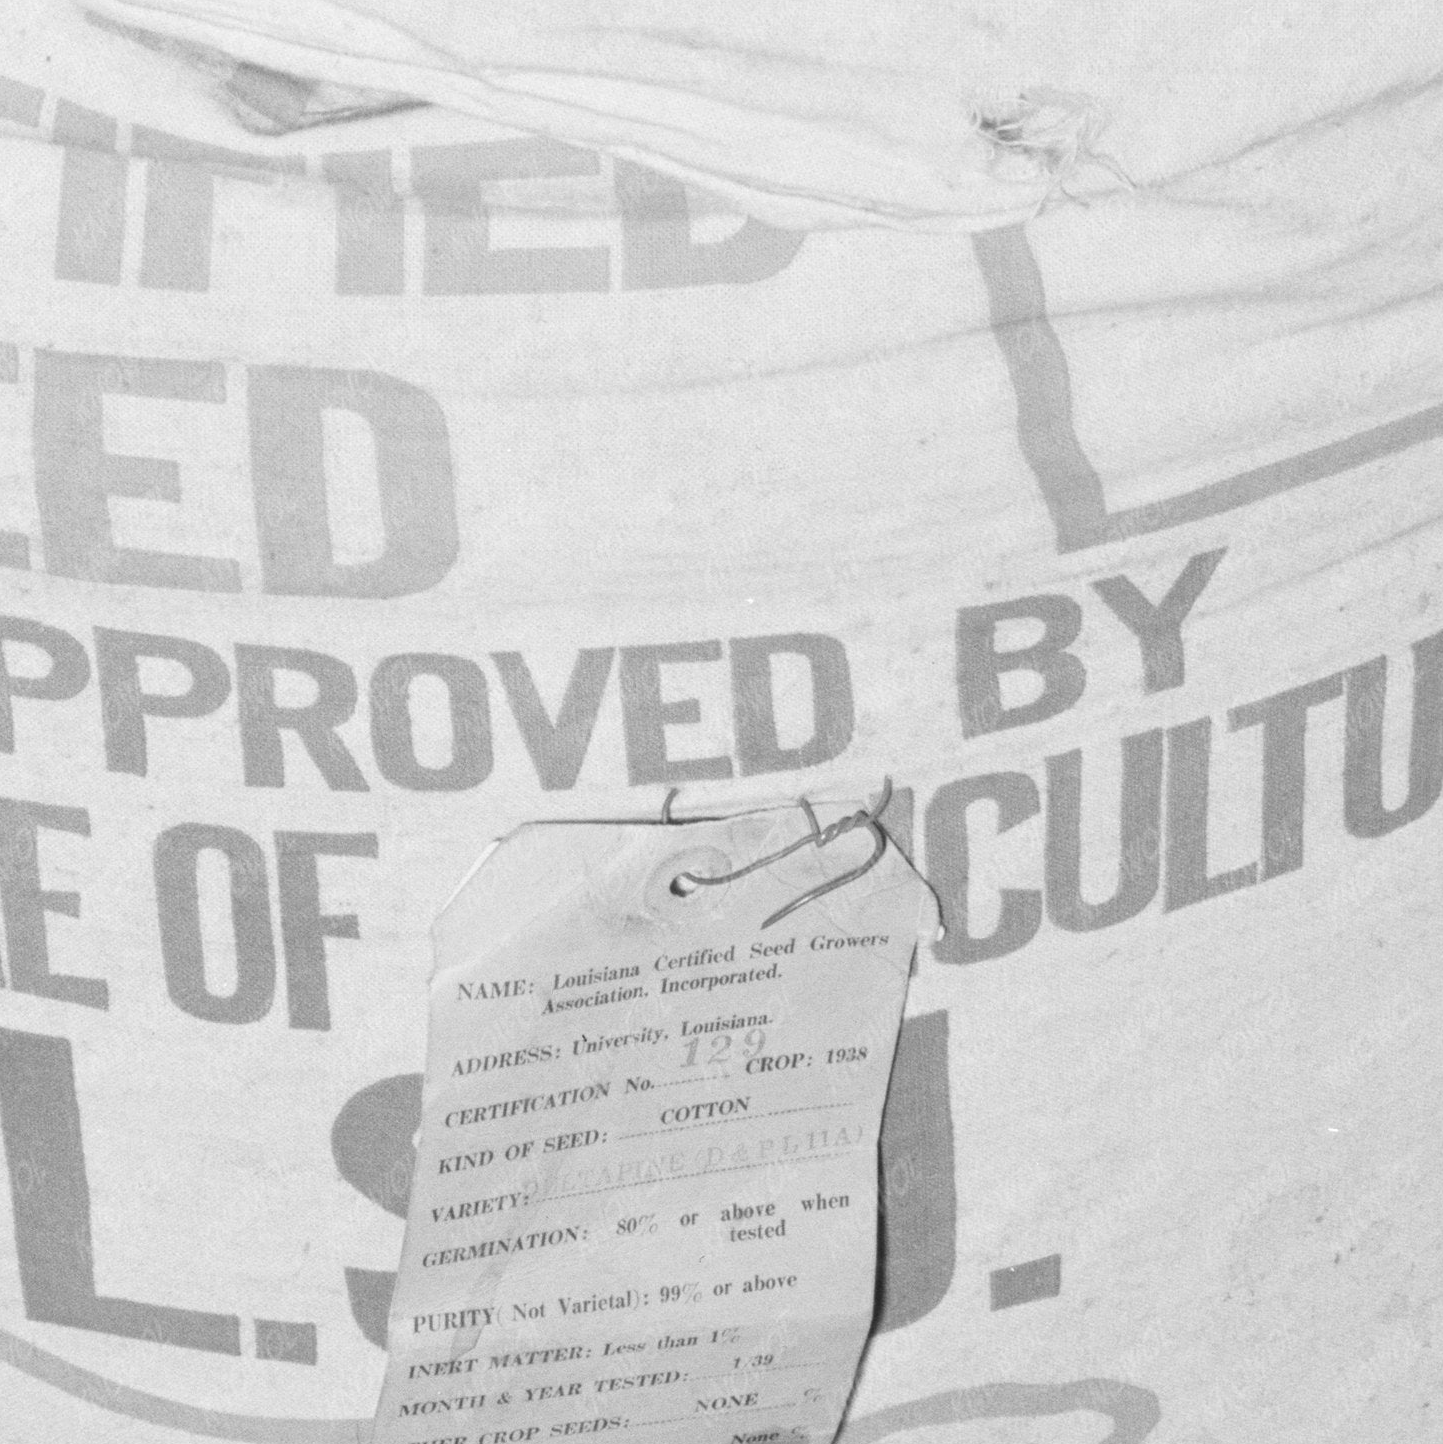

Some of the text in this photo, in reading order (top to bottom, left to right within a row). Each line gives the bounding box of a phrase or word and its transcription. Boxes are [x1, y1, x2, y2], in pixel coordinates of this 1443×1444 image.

[954, 546, 1230, 743] BY
[151, 819, 382, 1034] OF
[456, 931, 890, 1002] NAME: Louisiana Certified Seed Growers
[541, 963, 783, 1016] Association, Incorporated.
[450, 1013, 775, 1079] ADDRESS: University, Louisiana.
[445, 1027, 869, 1129] CERTIFICATION No. 129 CROP: 1938
[438, 1096, 751, 1175] KIND OF SEED: COTTON
[422, 1193, 851, 1269] GERMINATION: 80% or above when
[431, 1191, 531, 1224] VARIETY:
[729, 1219, 787, 1244] tested
[511, 1300, 546, 1323] Not
[557, 1288, 650, 1316] Varietal):
[659, 1281, 703, 1304] 99%
[712, 1280, 732, 1298] or
[741, 1272, 799, 1295] above
[408, 1357, 478, 1380] INERT
[487, 1345, 593, 1371] MATTER:
[602, 1339, 647, 1358] Less
[657, 1333, 699, 1351] than
[398, 1393, 487, 1419] MONTH
[496, 1390, 516, 1405] &
[524, 1382, 583, 1402] YEAR
[593, 1368, 691, 1393] TESTED:
[549, 1415, 631, 1438] SEEDS:
[694, 1392, 760, 1413] NONE
